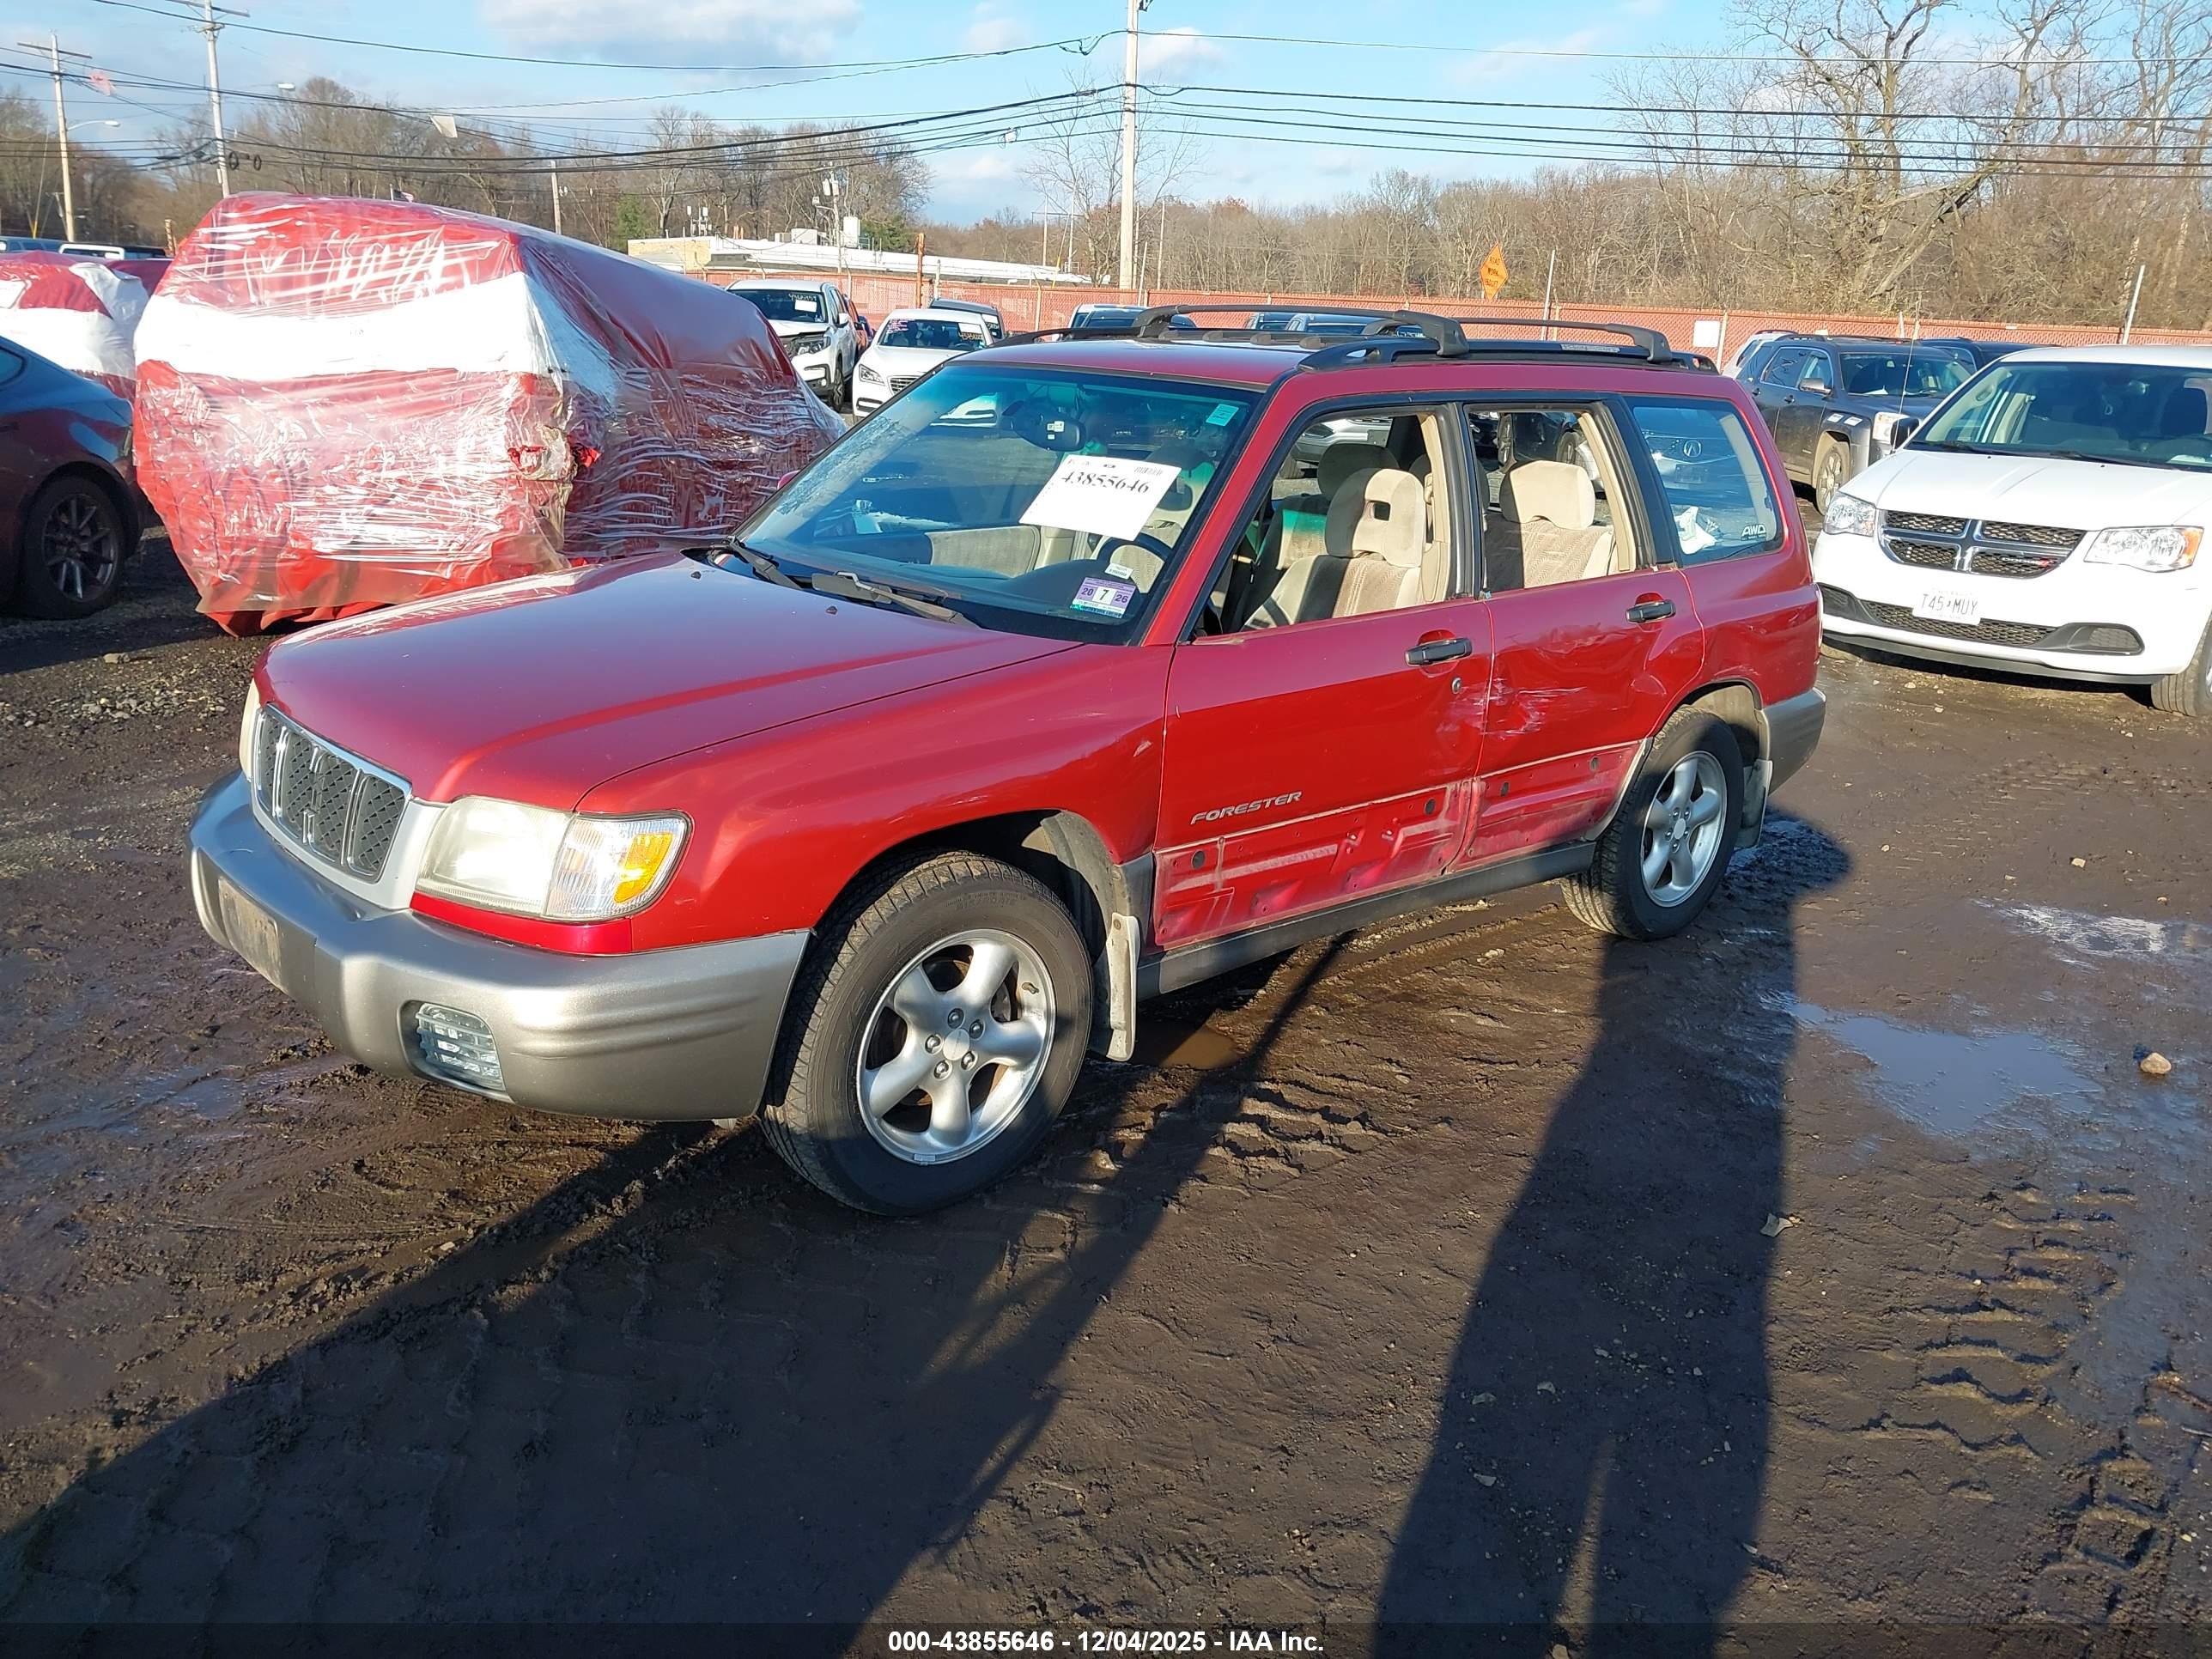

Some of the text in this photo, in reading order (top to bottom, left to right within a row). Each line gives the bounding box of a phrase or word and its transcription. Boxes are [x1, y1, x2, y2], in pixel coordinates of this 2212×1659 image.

[1061, 471, 1152, 494] 43855646
[1741, 524, 1766, 537] AWD
[1081, 586, 1129, 604] 20 7 26
[1921, 592, 1978, 616] T45 MUY
[1190, 790, 1303, 825] FORESTER
